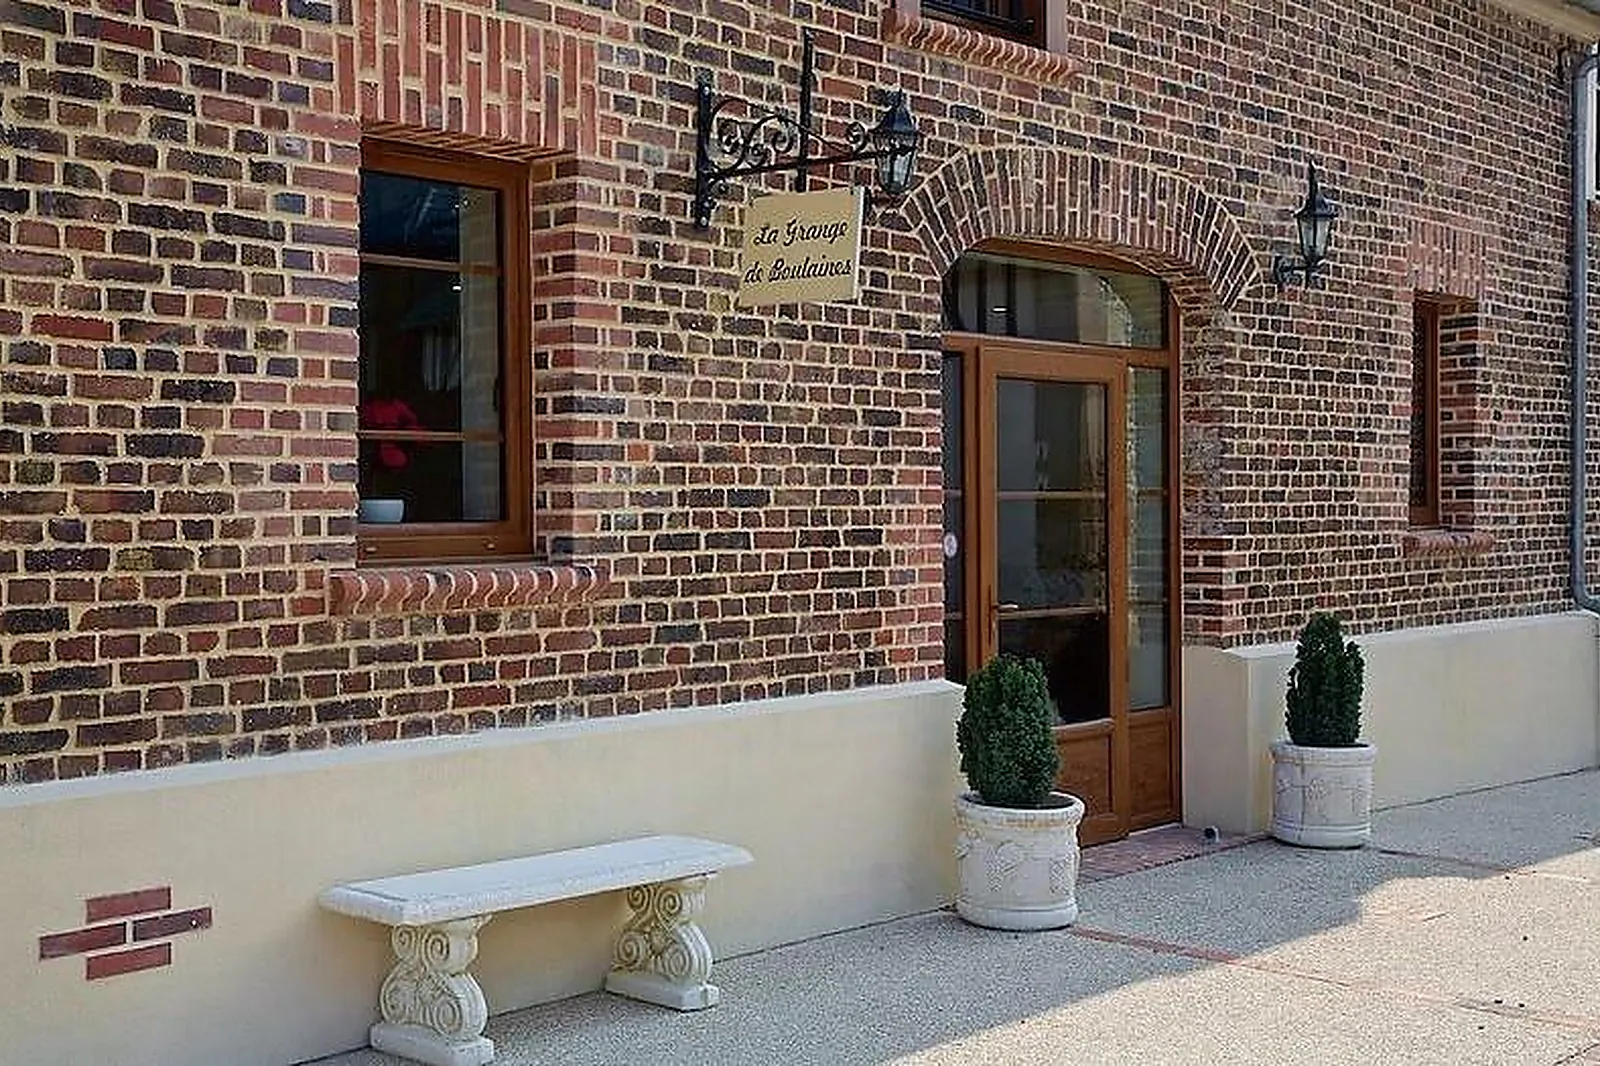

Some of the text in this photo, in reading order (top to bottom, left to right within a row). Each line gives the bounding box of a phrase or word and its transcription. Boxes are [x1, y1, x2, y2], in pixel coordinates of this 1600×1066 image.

[754, 218, 848, 247] La Grange
[744, 261, 763, 283] de
